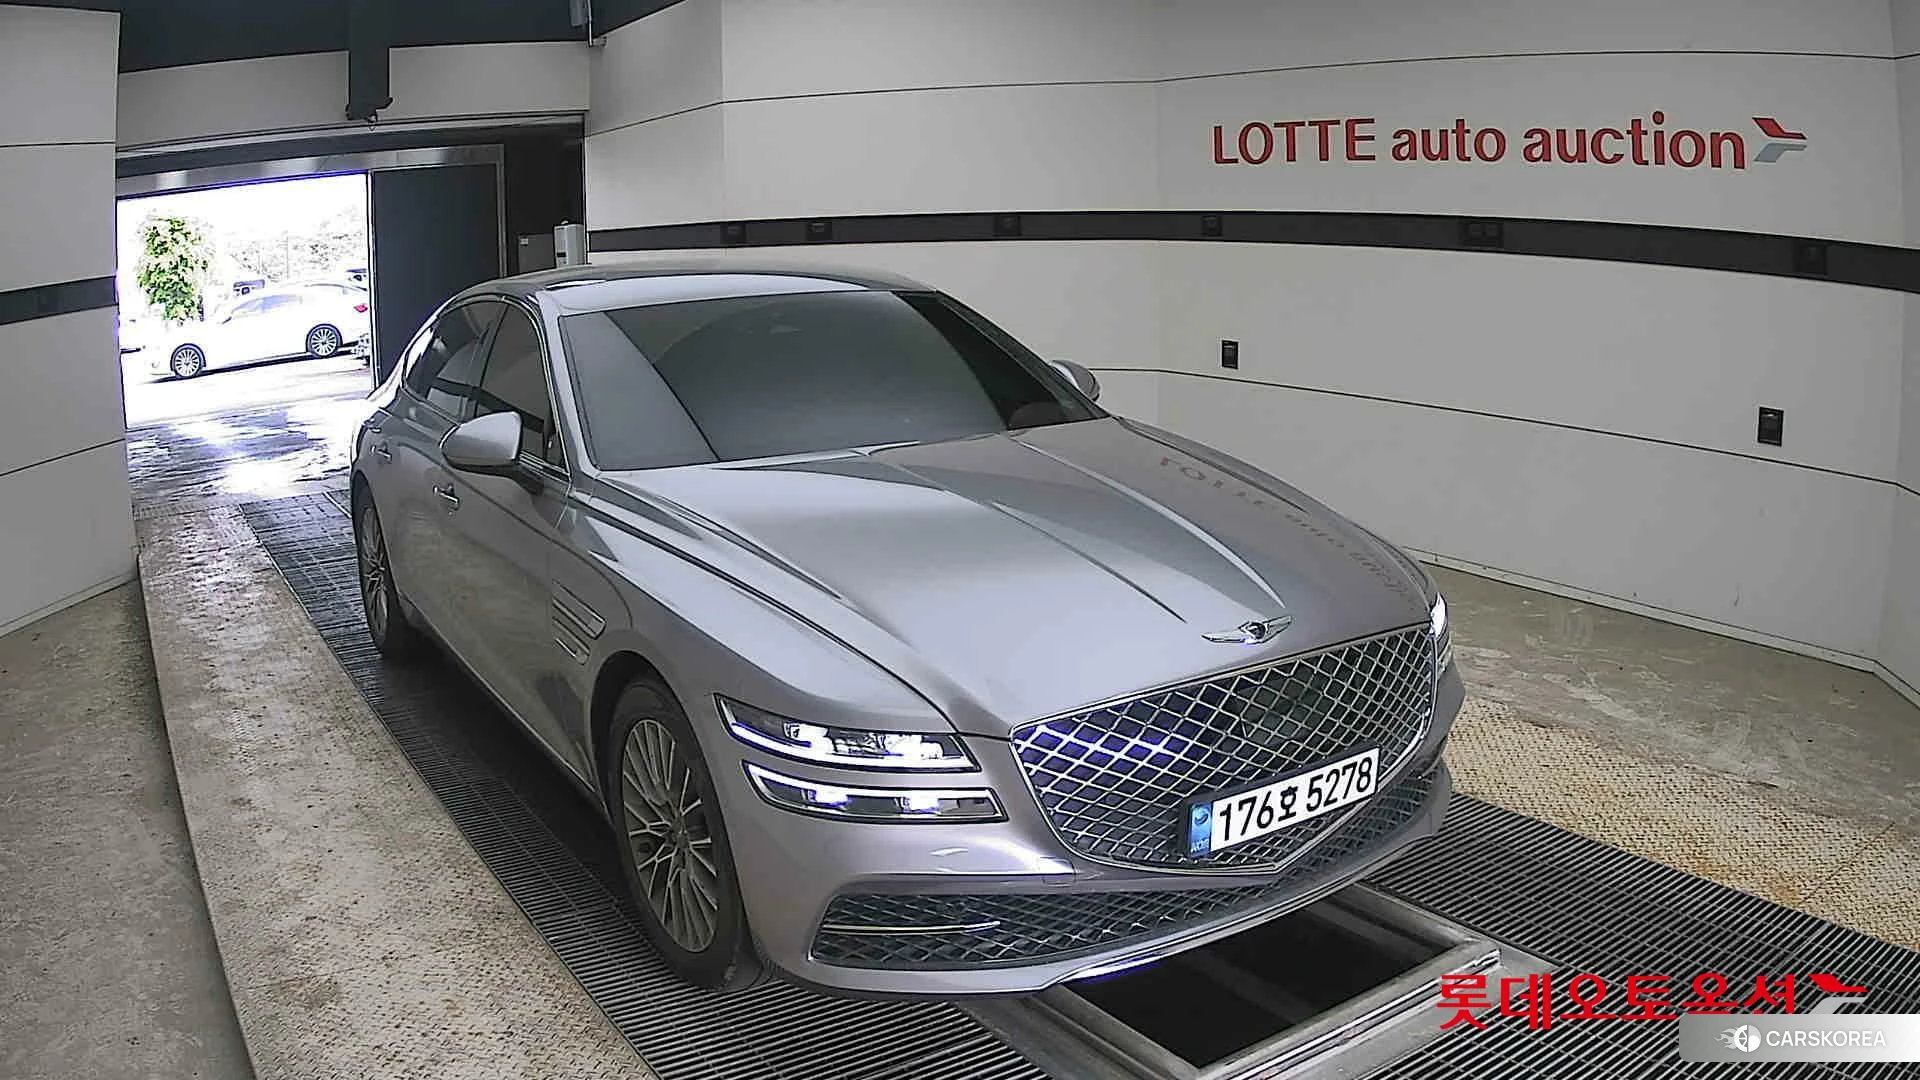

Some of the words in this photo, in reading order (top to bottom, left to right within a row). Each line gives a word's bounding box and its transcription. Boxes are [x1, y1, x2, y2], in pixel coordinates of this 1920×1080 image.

[1213, 118, 1376, 165] LOTTE
[1392, 117, 1506, 163] auto
[1523, 110, 1746, 170] auction
[1305, 756, 1373, 813] 5278
